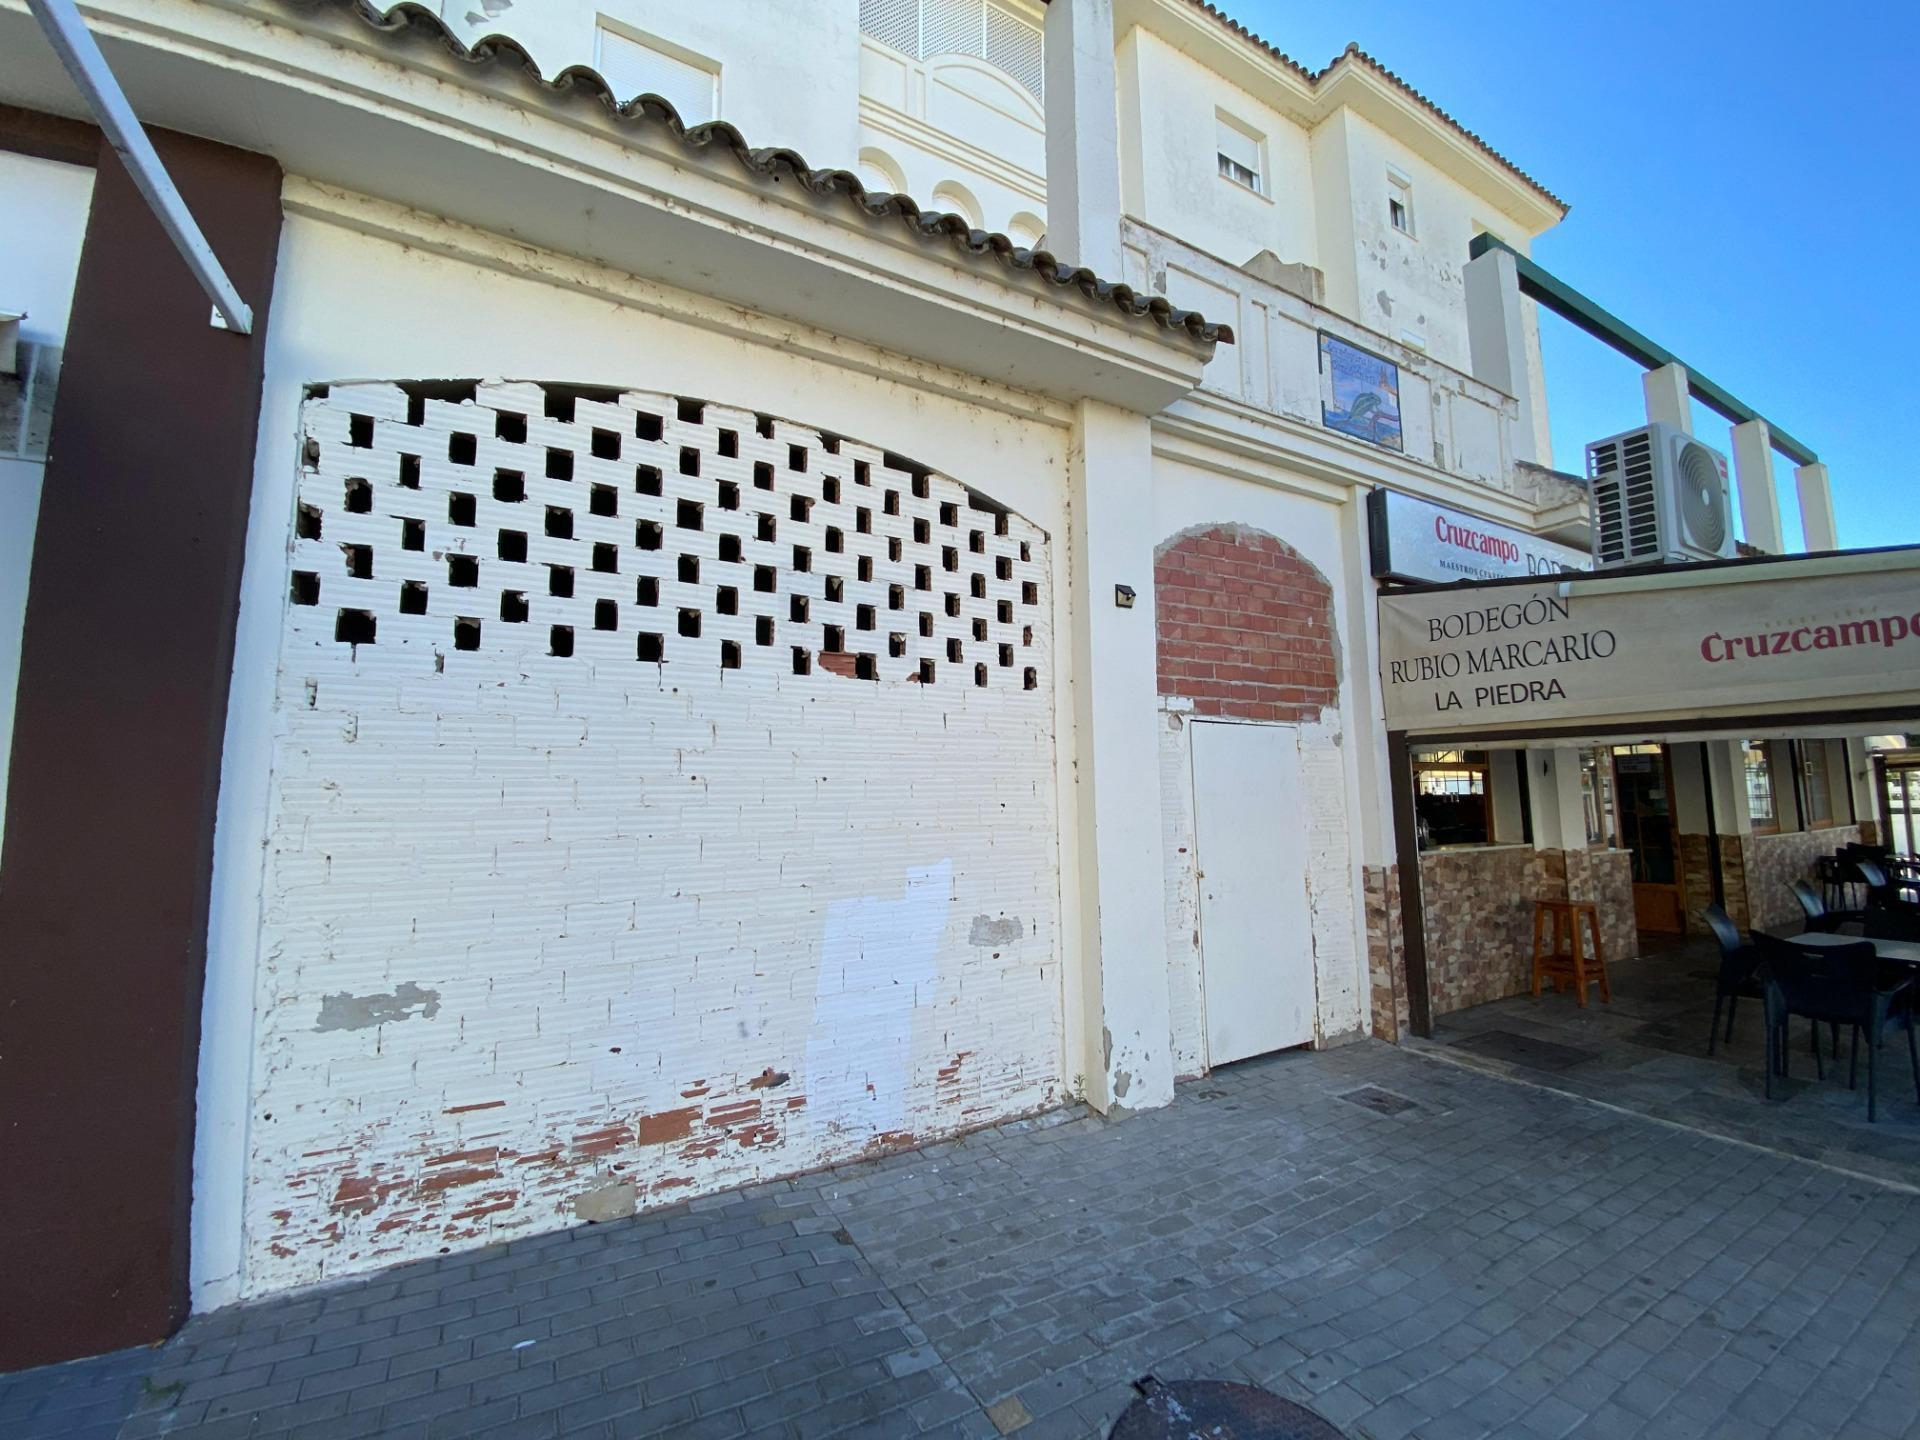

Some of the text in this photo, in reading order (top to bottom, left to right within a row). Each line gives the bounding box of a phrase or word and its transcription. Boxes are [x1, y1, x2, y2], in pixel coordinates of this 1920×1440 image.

[1435, 515, 1519, 564] Cruzcampo
[1439, 559, 1478, 576] MAESTROS
[1427, 593, 1570, 642] BODEGÓN
[1390, 629, 1616, 684] RUBIO MARCARIO
[1435, 678, 1567, 711] LA PIEDRA
